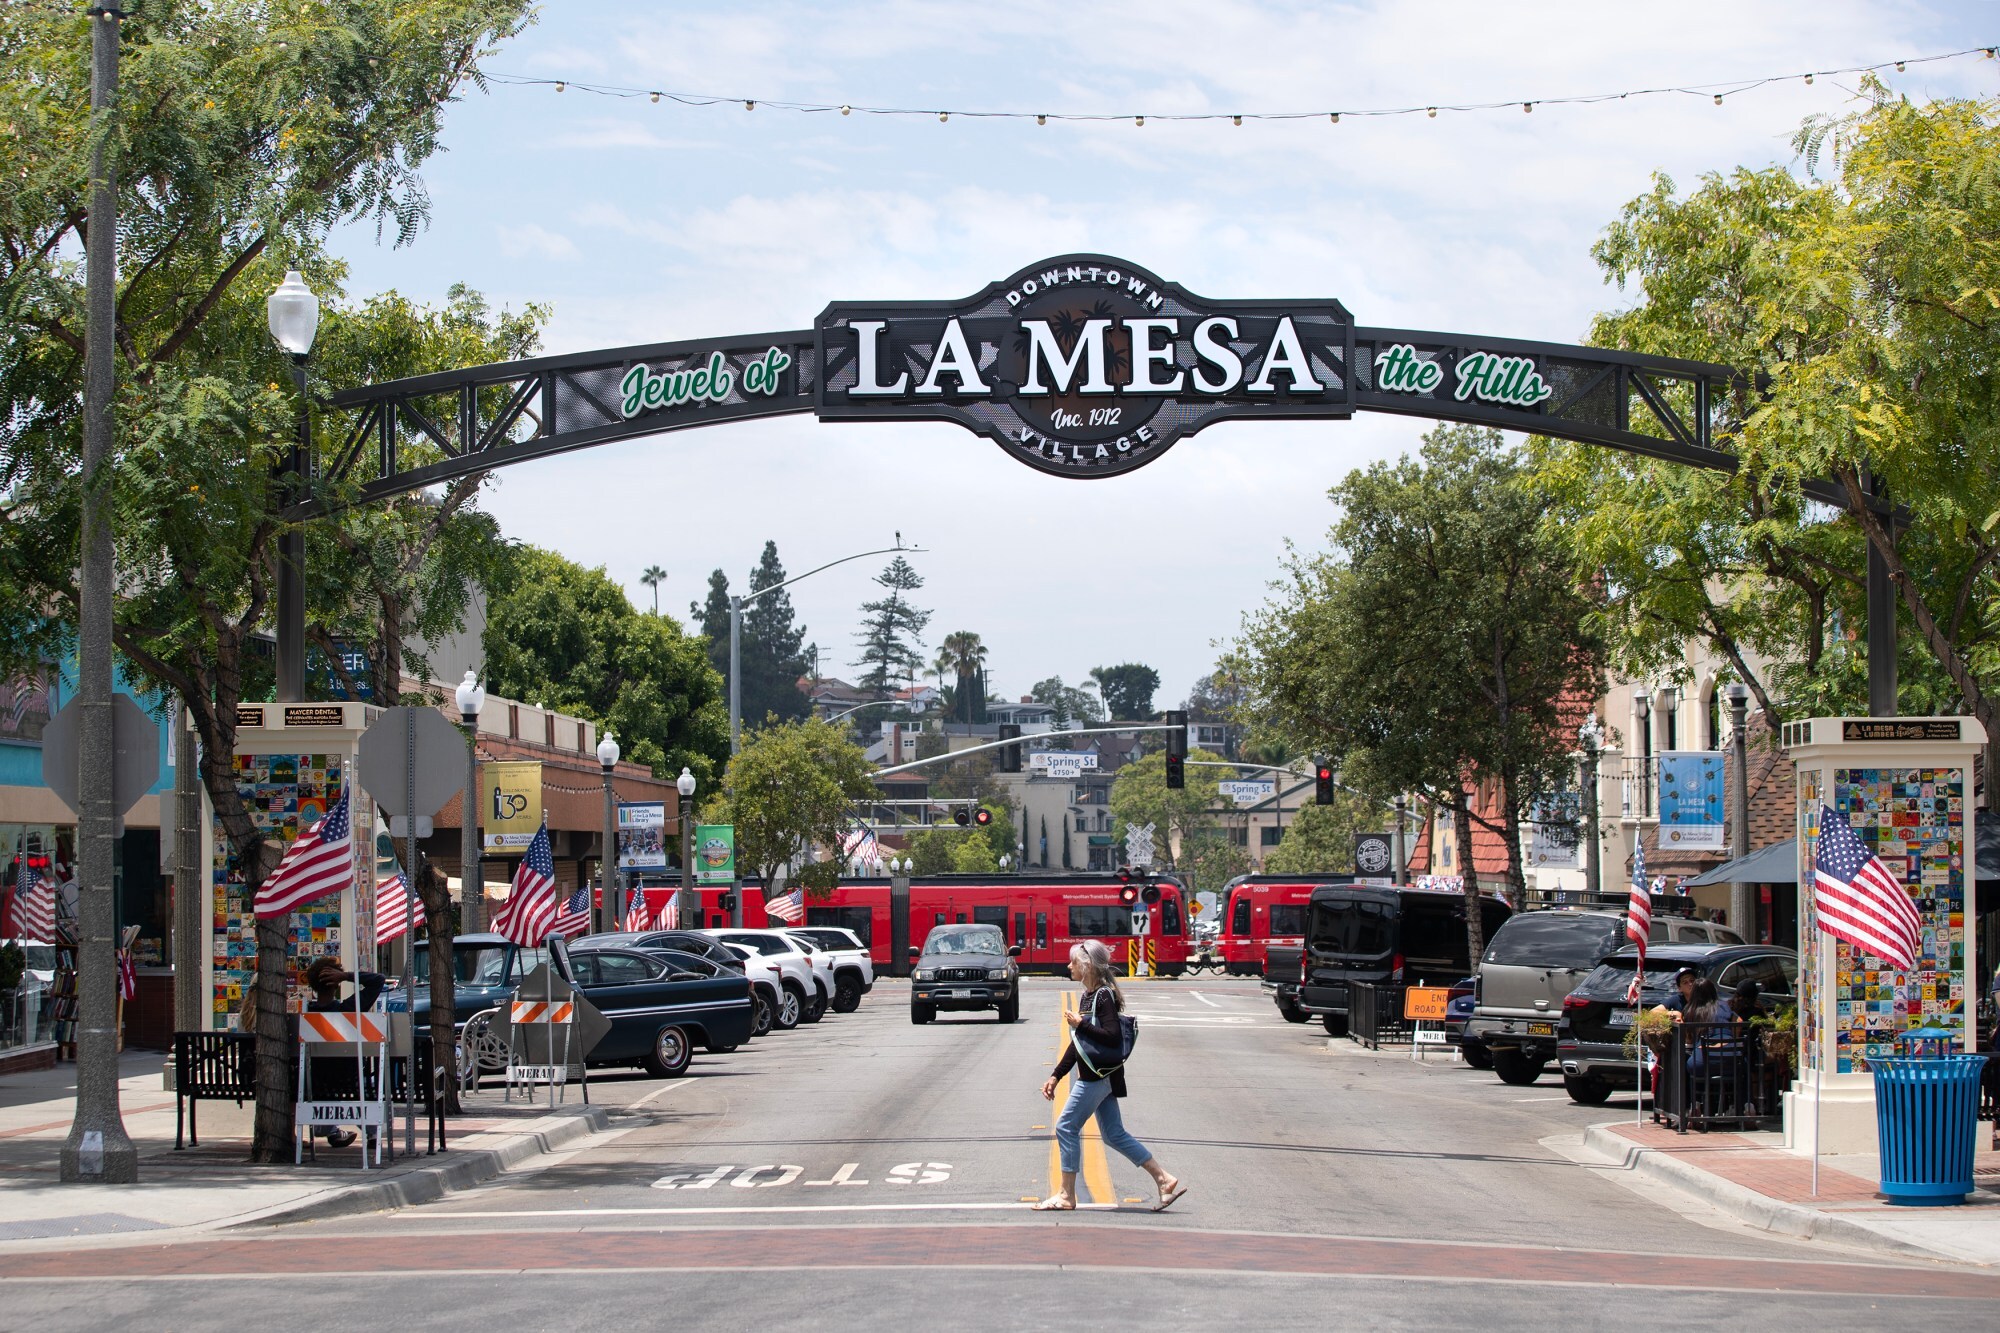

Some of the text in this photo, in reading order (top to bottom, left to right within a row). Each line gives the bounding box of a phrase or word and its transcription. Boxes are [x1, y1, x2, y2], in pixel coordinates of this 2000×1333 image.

[1006, 266, 1164, 309] DOWNTOWN
[847, 315, 1324, 395] LA MESA
[622, 346, 791, 418] Jewel of
[1375, 344, 1552, 406] the Hills
[1051, 407, 1122, 430] Inc. 1912
[1020, 425, 1153, 460] VILLAGE
[1047, 755, 1095, 769] Spring St
[1232, 784, 1271, 795] Spring St
[1678, 798, 1706, 806] LA MESA
[1127, 823, 1155, 851] RAIL ROAD
[1128, 824, 1154, 851] CROSSING
[1415, 1004, 1437, 1014] ROAD
[1431, 994, 1448, 1003] END
[1422, 1032, 1445, 1041] MERA
[517, 1068, 556, 1079] MERAM
[312, 1106, 367, 1120] MERAM
[650, 1162, 954, 1190] STOP
